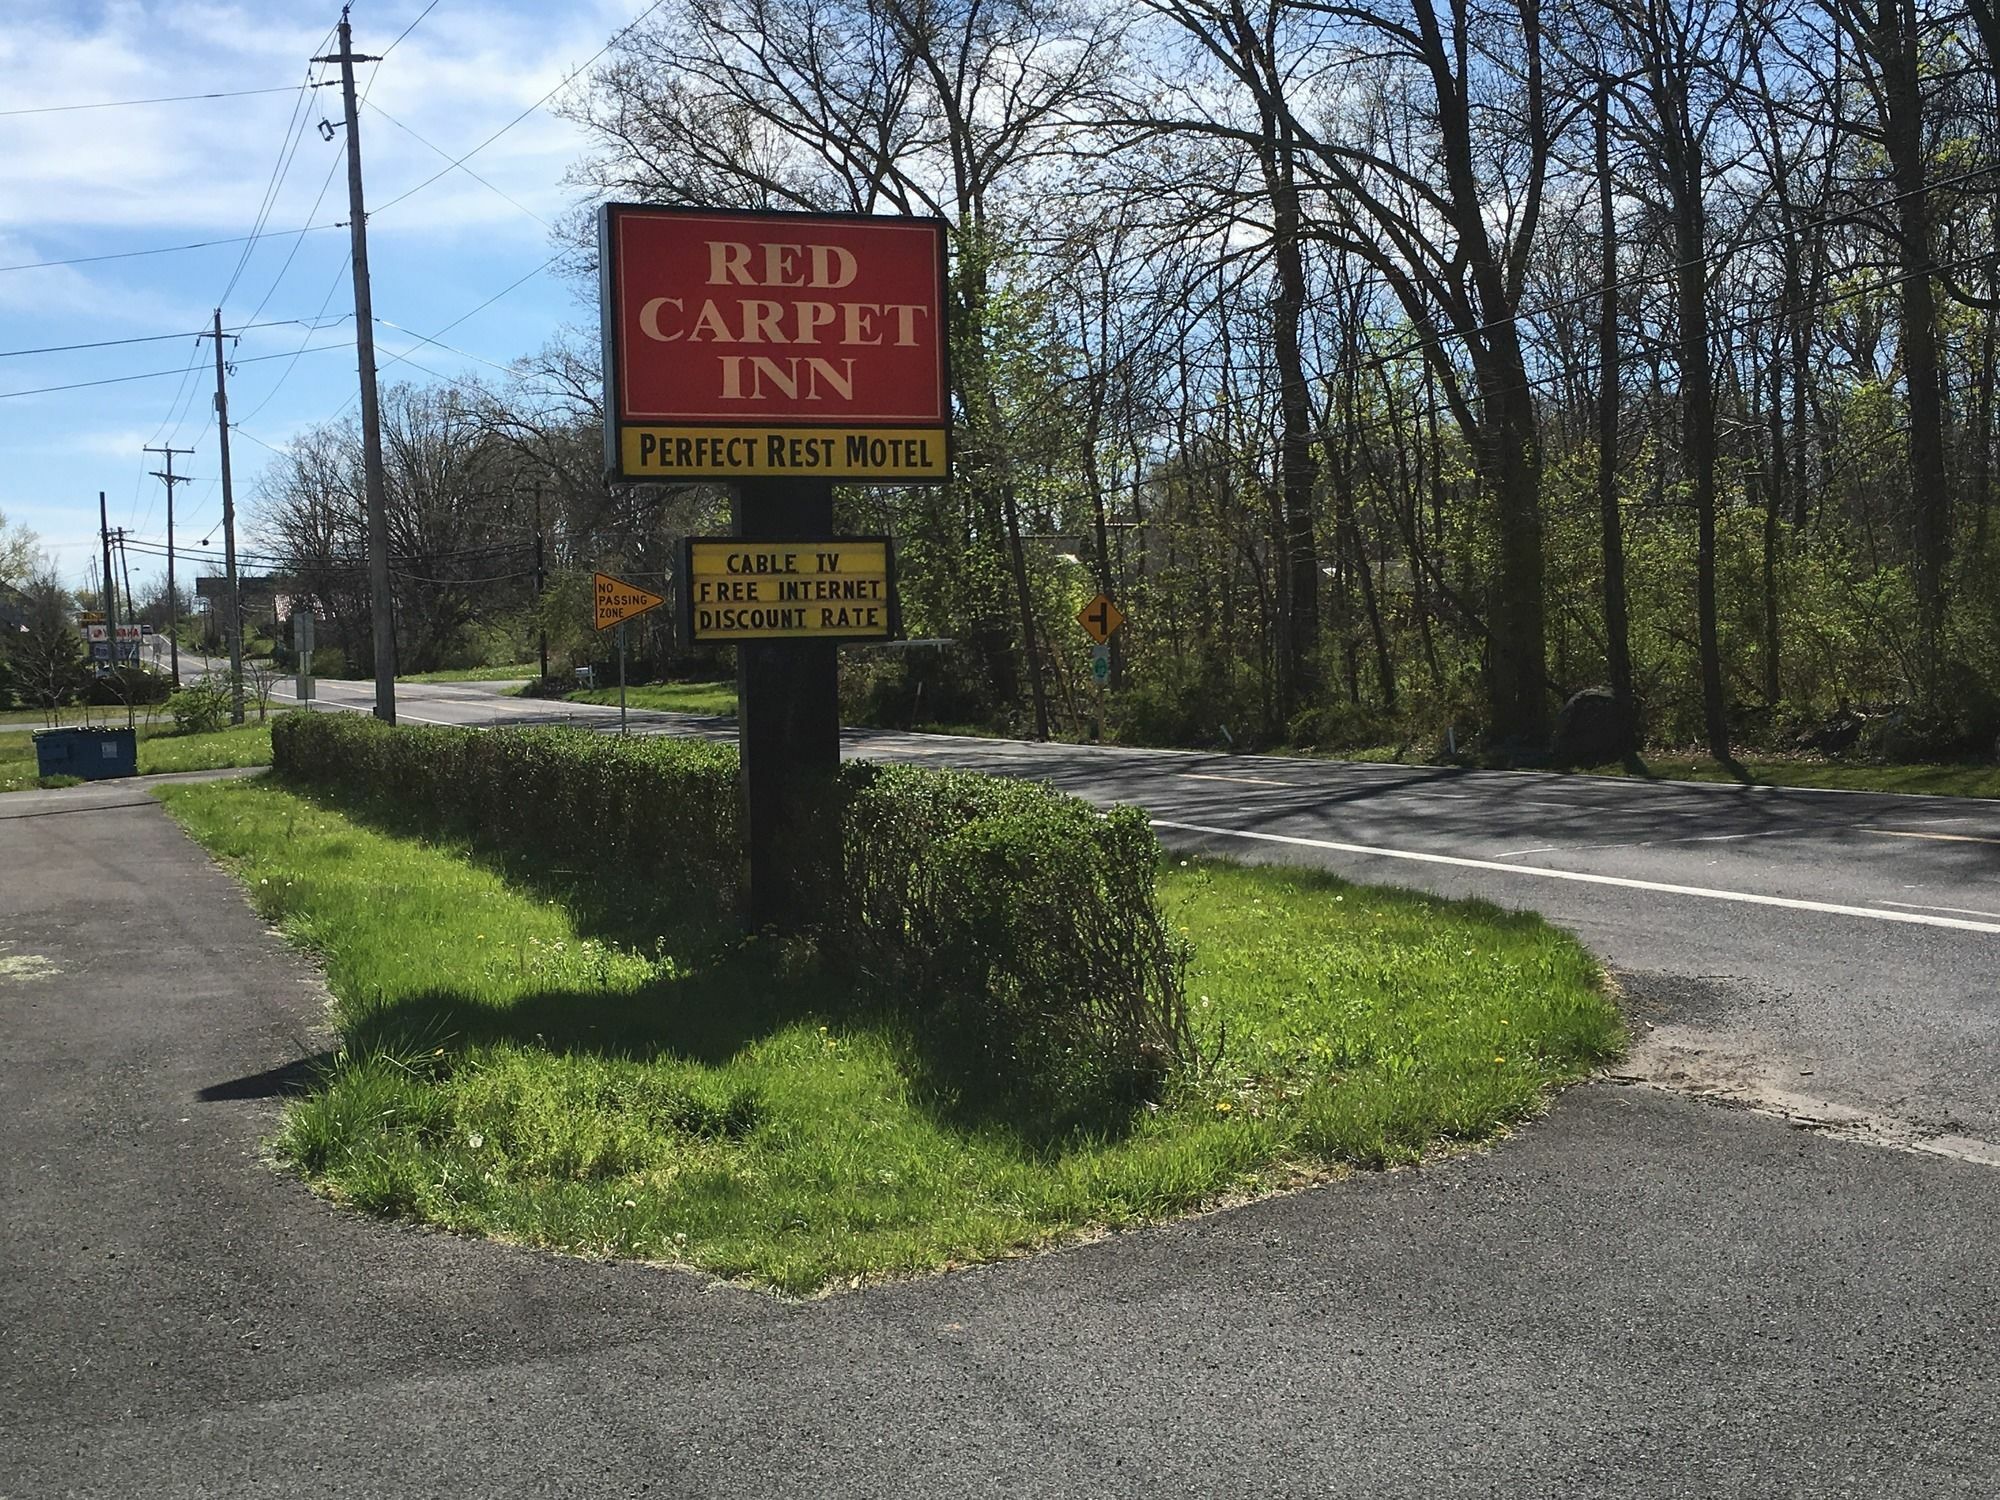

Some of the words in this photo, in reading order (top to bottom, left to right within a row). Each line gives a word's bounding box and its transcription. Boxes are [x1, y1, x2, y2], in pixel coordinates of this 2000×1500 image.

[704, 241, 858, 289] RED
[639, 297, 928, 347] CARPET
[717, 355, 856, 401] INN
[640, 433, 758, 467] PERFECT
[767, 435, 836, 467] REST
[846, 435, 933, 468] MOTEL
[726, 554, 797, 573] CABLE
[816, 553, 840, 572] TV
[598, 583, 614, 593] NO
[700, 582, 758, 601] FREE
[779, 580, 880, 600] INTERNET
[598, 595, 647, 606] PASSING
[599, 608, 624, 618] ZONE
[700, 608, 806, 630] DISCOUNT
[821, 607, 879, 627] RATE
